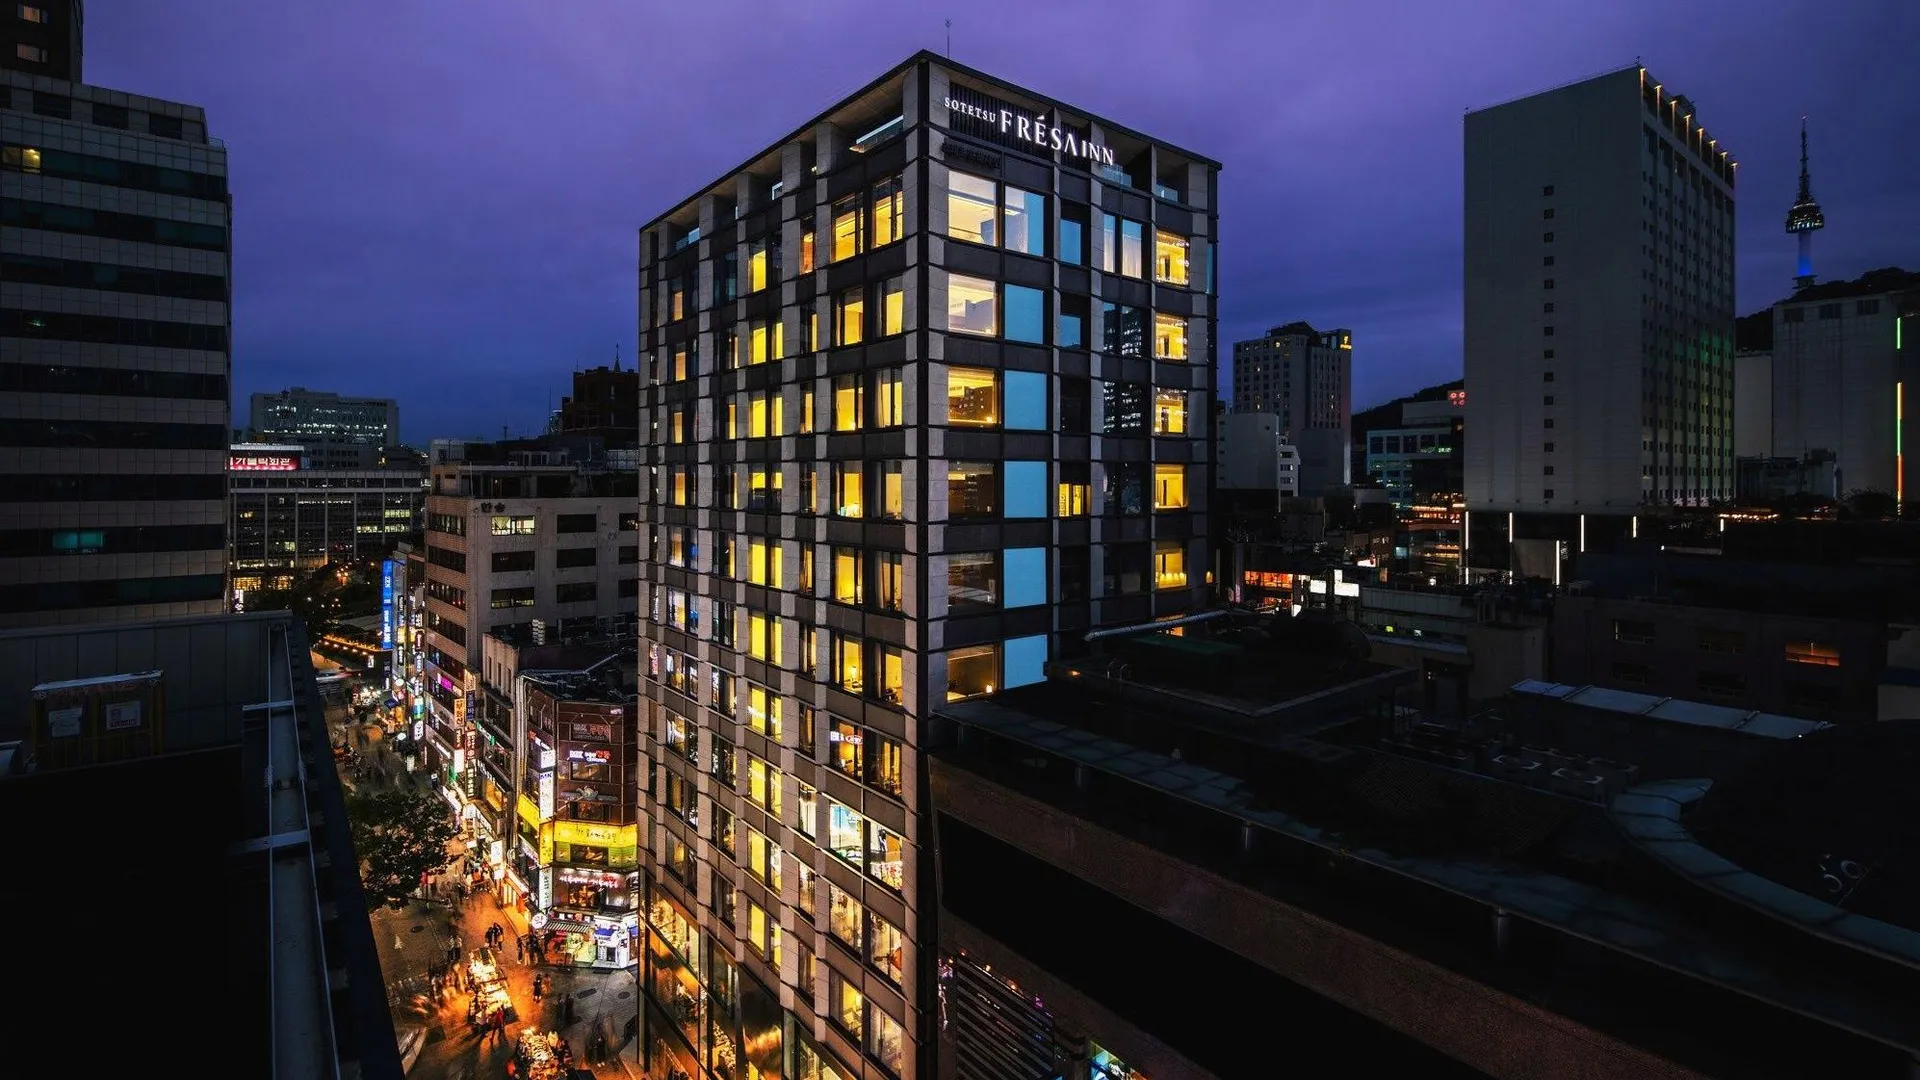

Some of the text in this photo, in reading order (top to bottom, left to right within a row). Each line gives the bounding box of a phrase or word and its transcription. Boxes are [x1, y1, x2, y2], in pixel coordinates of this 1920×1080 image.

[944, 97, 996, 123] SOTETSU
[1000, 109, 1078, 156] FRÉSA
[1081, 140, 1115, 165] INN
